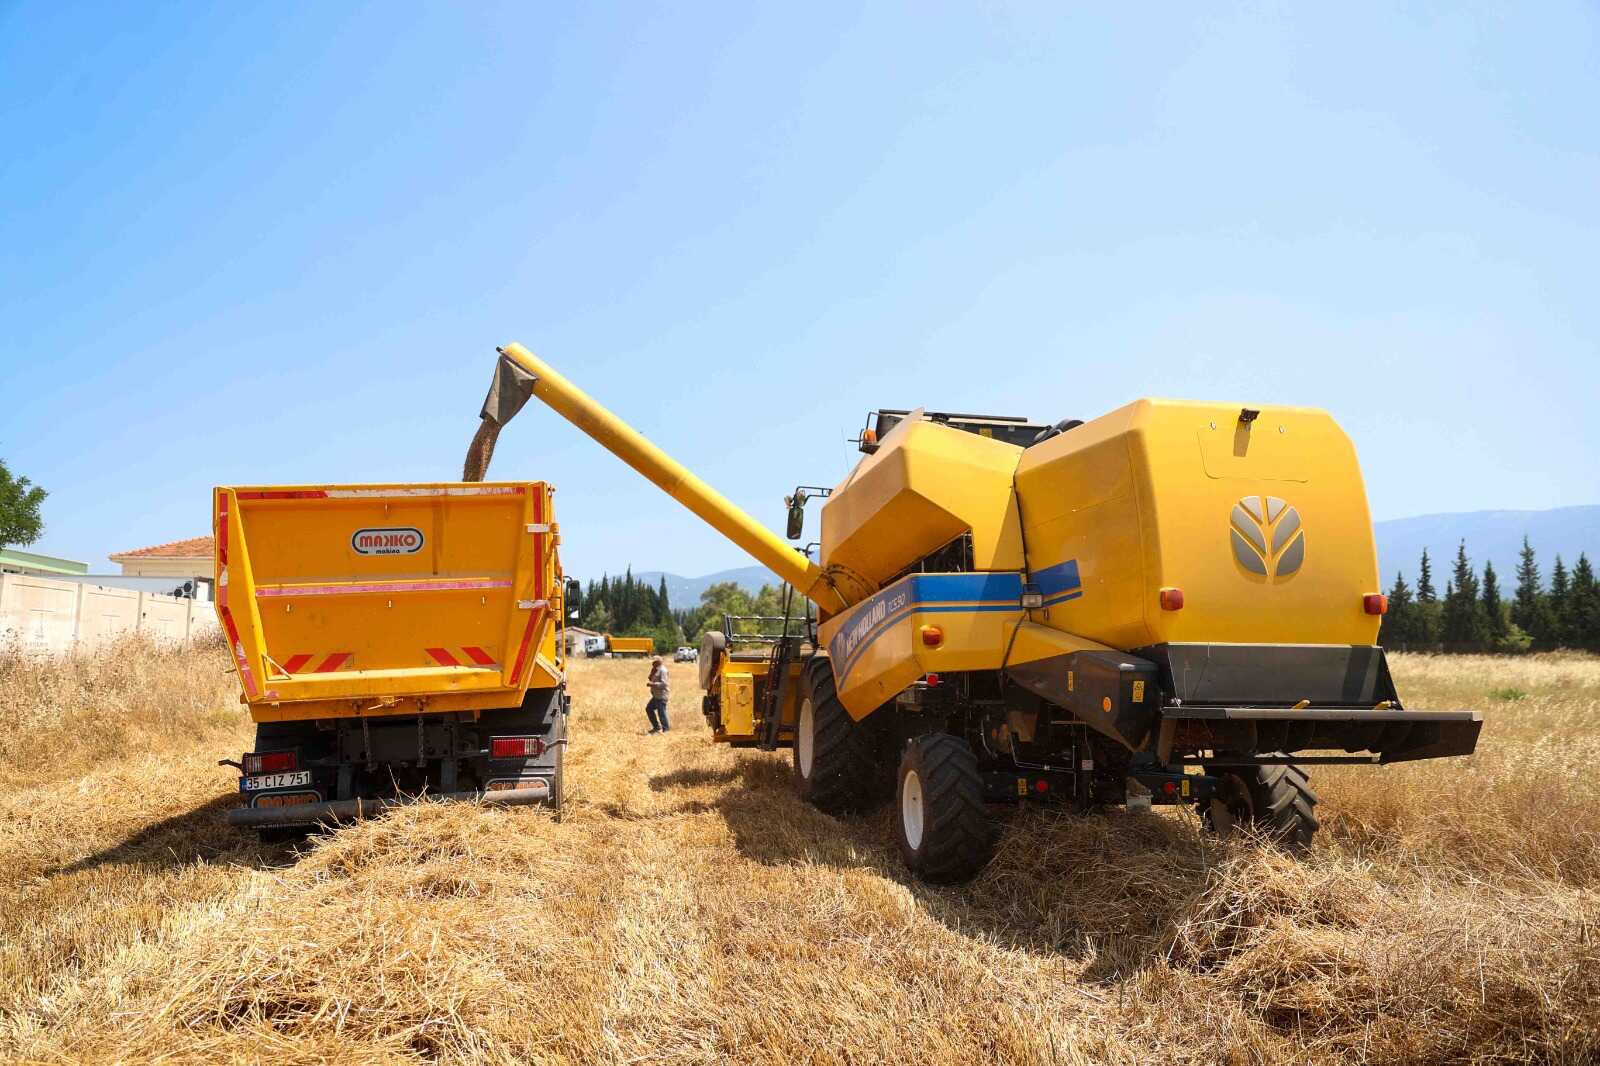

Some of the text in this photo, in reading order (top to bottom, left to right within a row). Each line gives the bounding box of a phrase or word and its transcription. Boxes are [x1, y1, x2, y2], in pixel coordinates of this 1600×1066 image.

[858, 600, 886, 640] HOLLAND
[247, 778, 260, 789] 35
[265, 775, 285, 787] CIZ
[289, 773, 309, 785] 751
